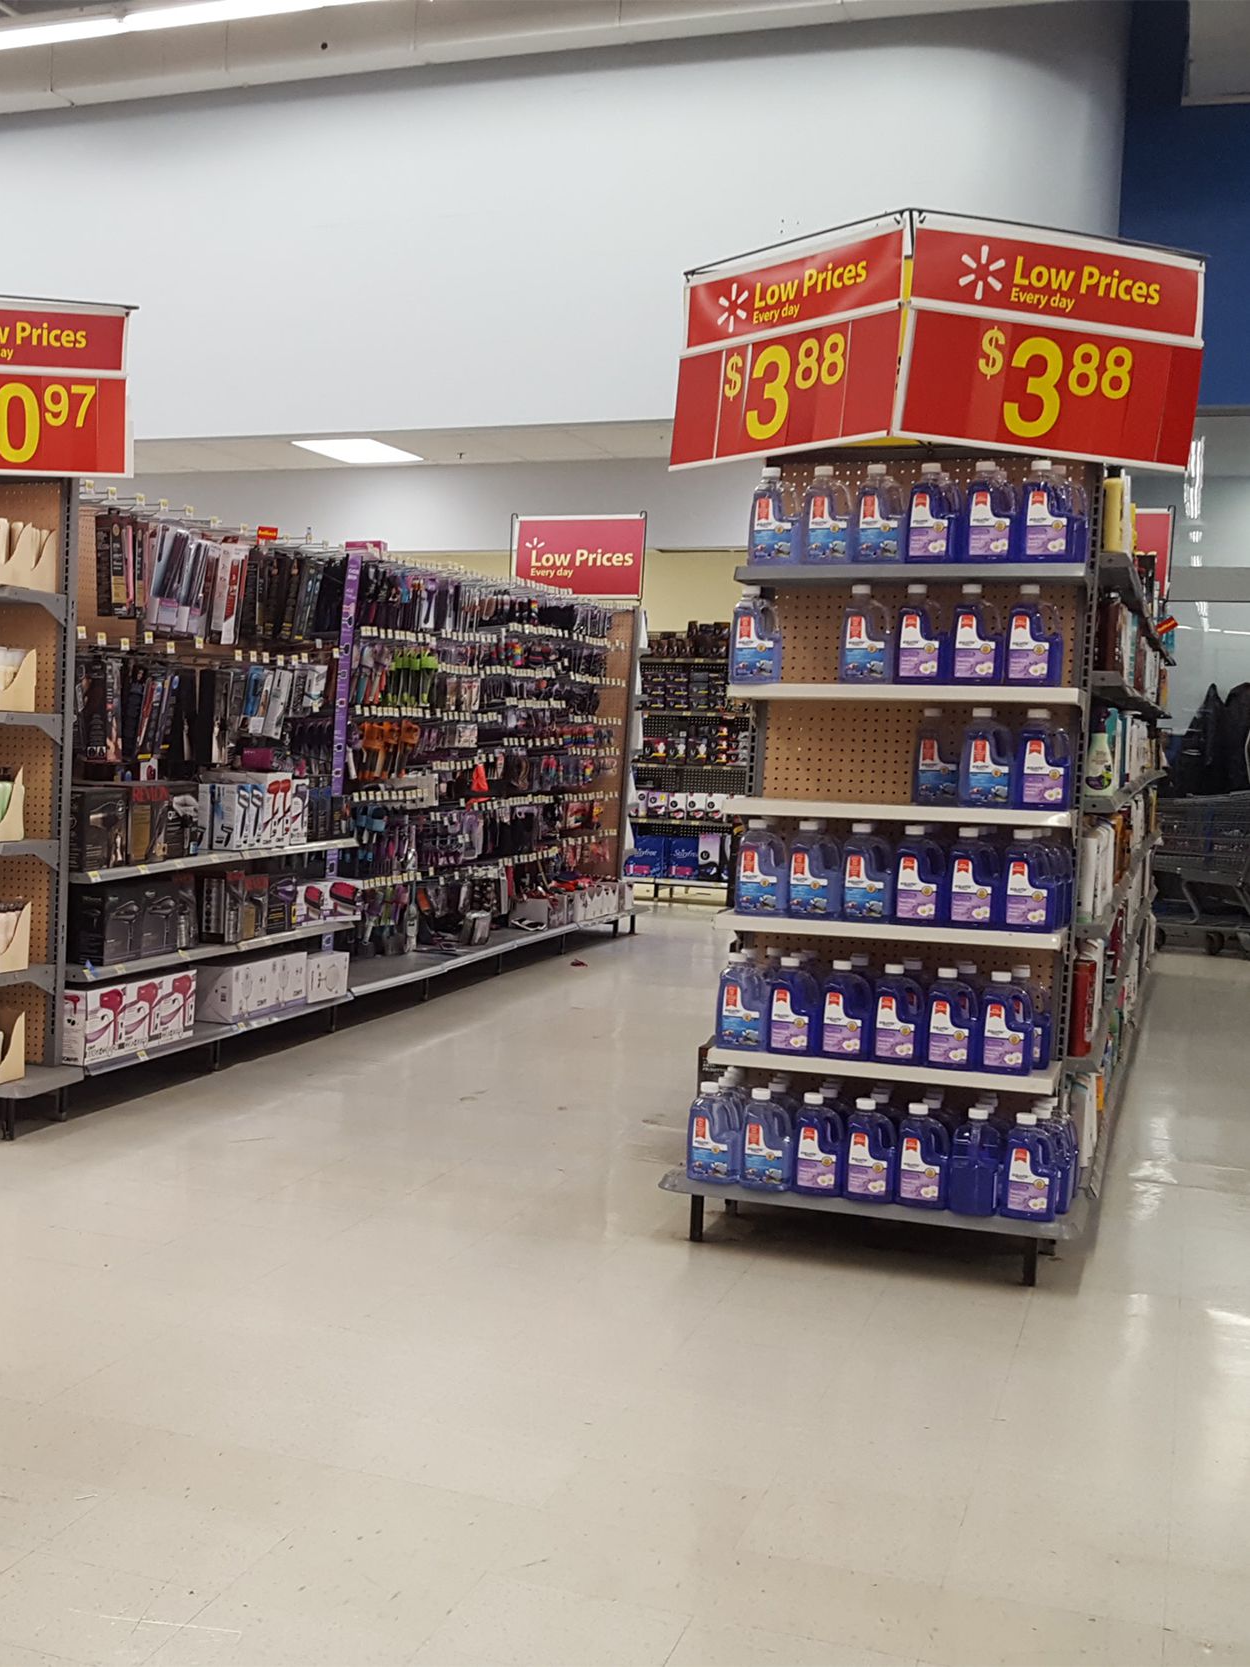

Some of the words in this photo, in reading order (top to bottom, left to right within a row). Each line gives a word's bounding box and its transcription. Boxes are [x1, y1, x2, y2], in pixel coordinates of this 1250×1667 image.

[753, 280, 797, 309] Low
[803, 258, 867, 295] Prices
[1013, 255, 1075, 290] Low
[1079, 265, 1160, 306] Prices
[1010, 287, 1047, 311] Every
[1049, 292, 1076, 313] day
[753, 308, 780, 326] Every
[781, 301, 800, 321] day
[16, 321, 87, 349] Prices
[530, 549, 571, 567] Low
[575, 548, 633, 567] Prices
[530, 568, 555, 578] Every
[556, 567, 574, 578] day
